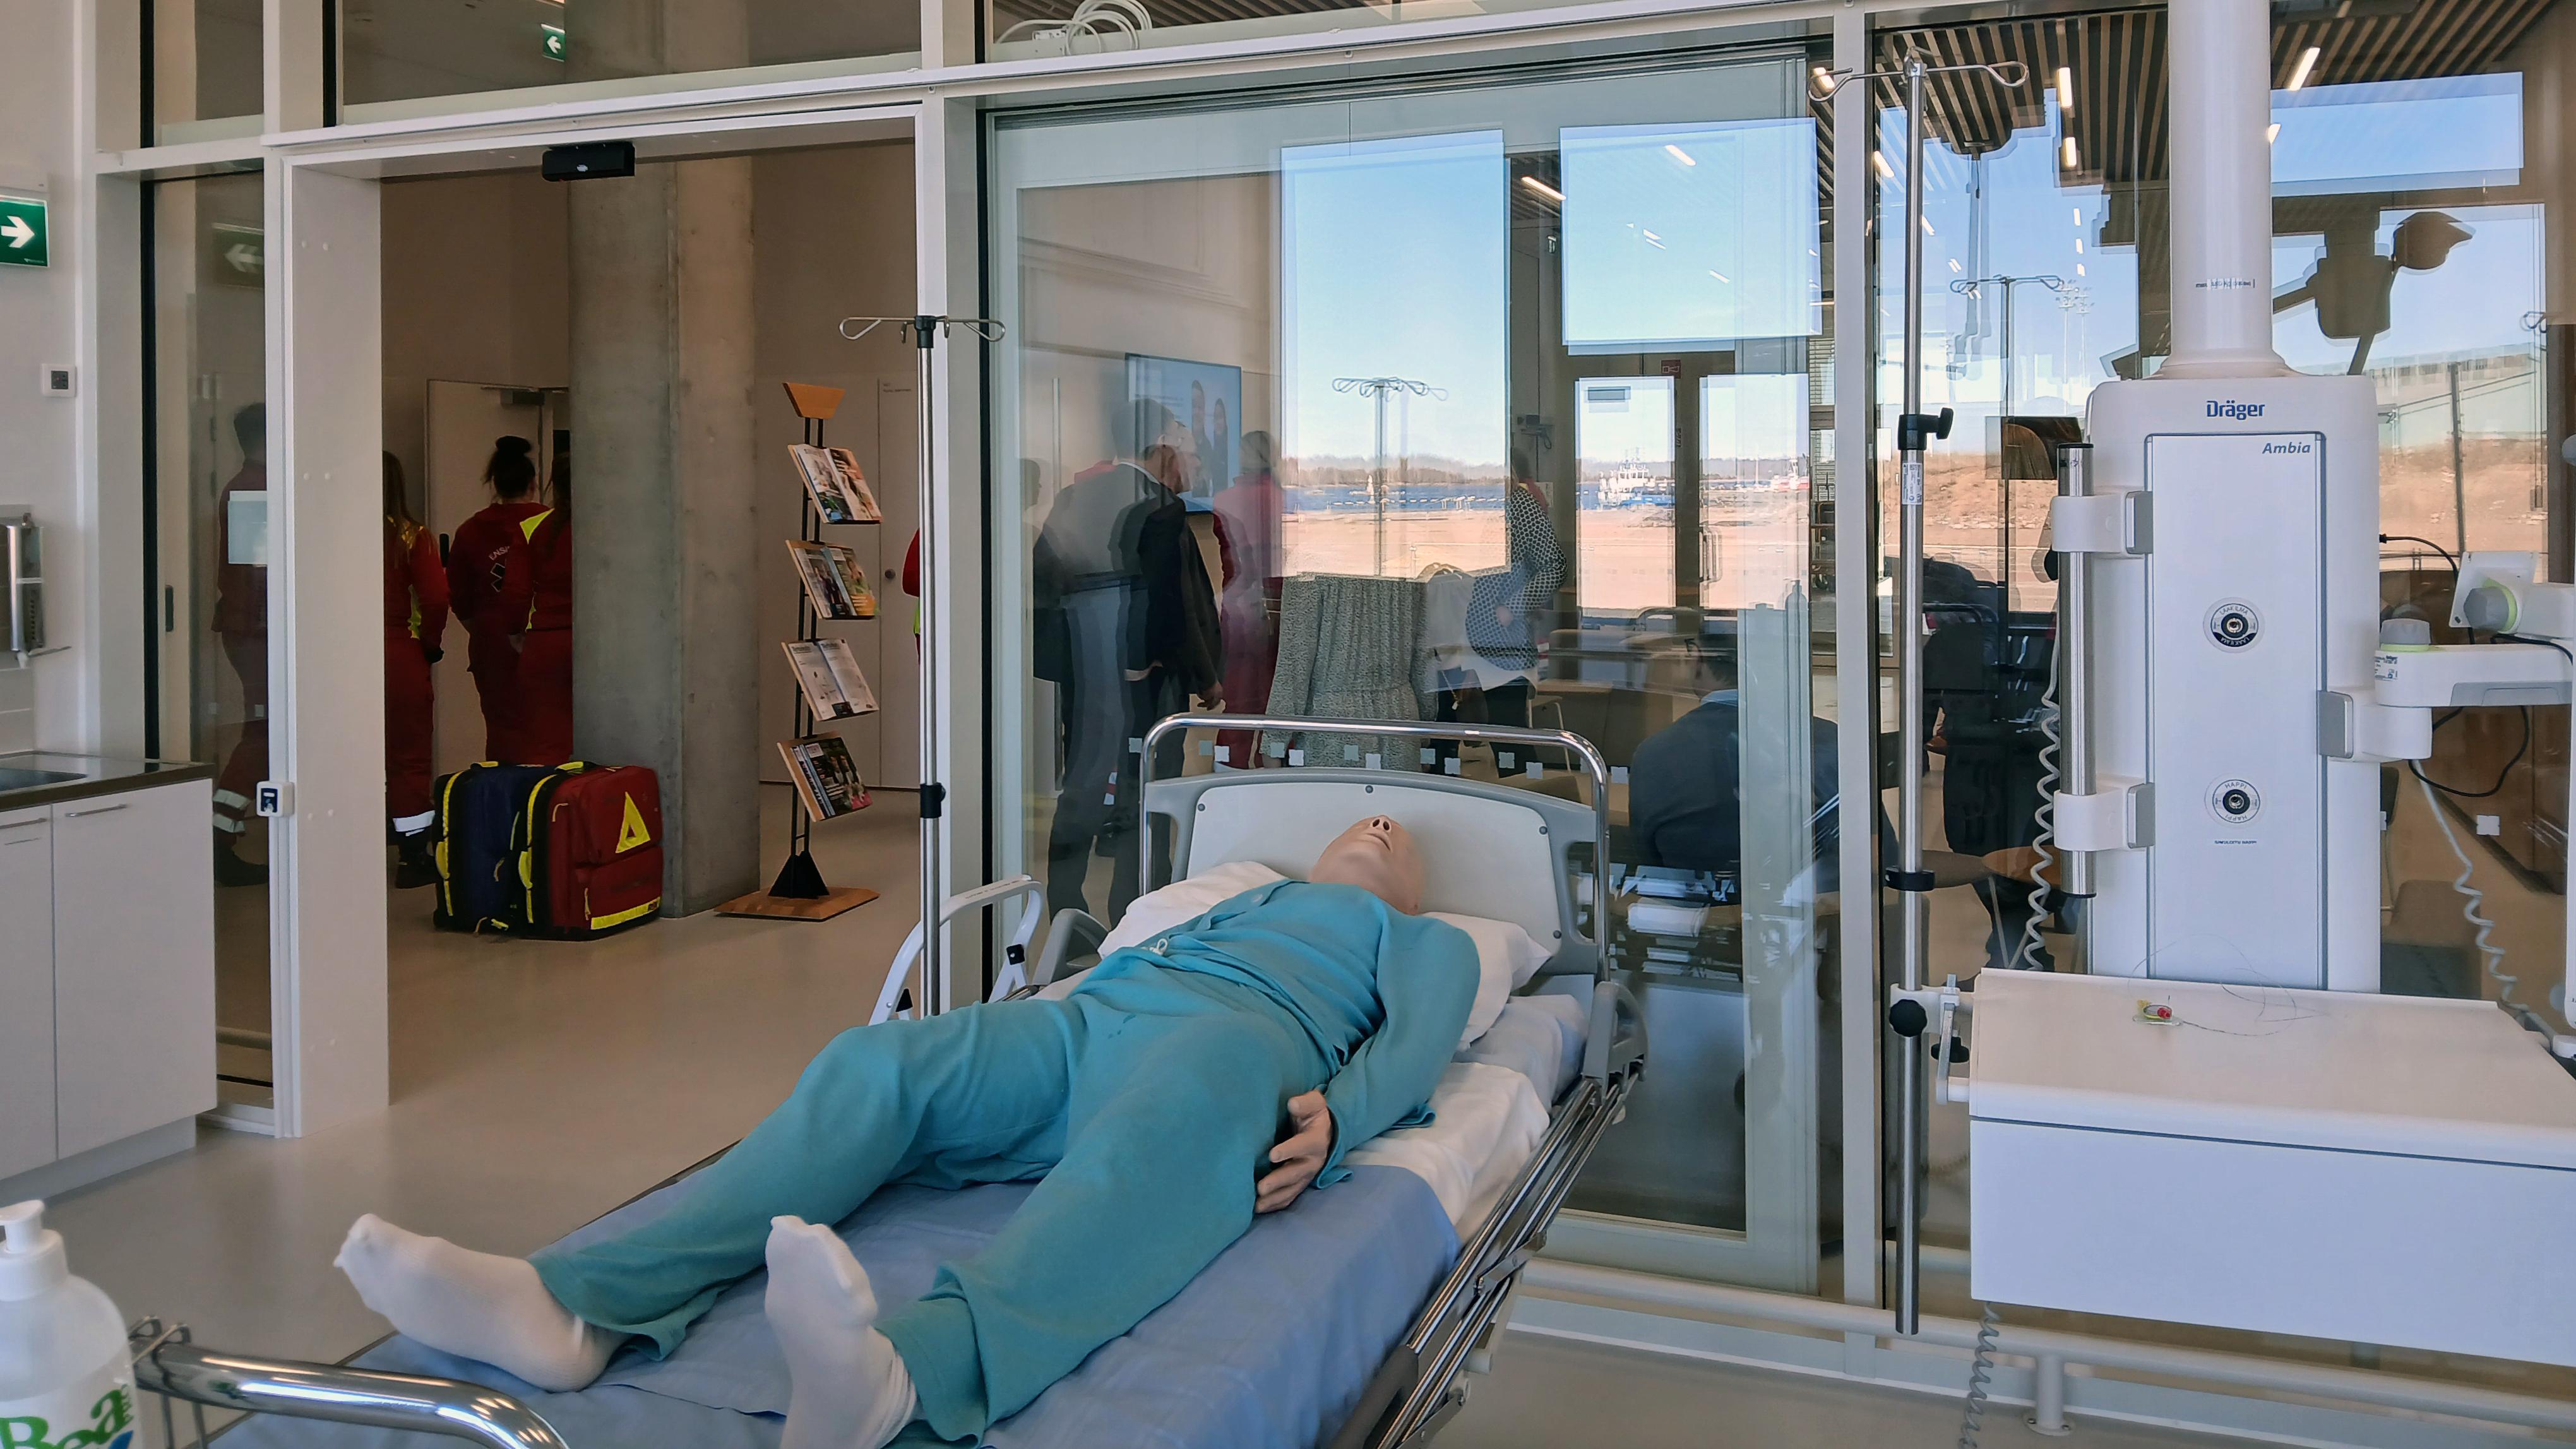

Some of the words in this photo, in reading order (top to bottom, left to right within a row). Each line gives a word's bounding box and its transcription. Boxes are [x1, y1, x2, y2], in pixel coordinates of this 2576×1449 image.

[2207, 400, 2265, 420] Dräger
[2262, 442, 2311, 454] Ambia
[489, 546, 510, 561] ENSI
